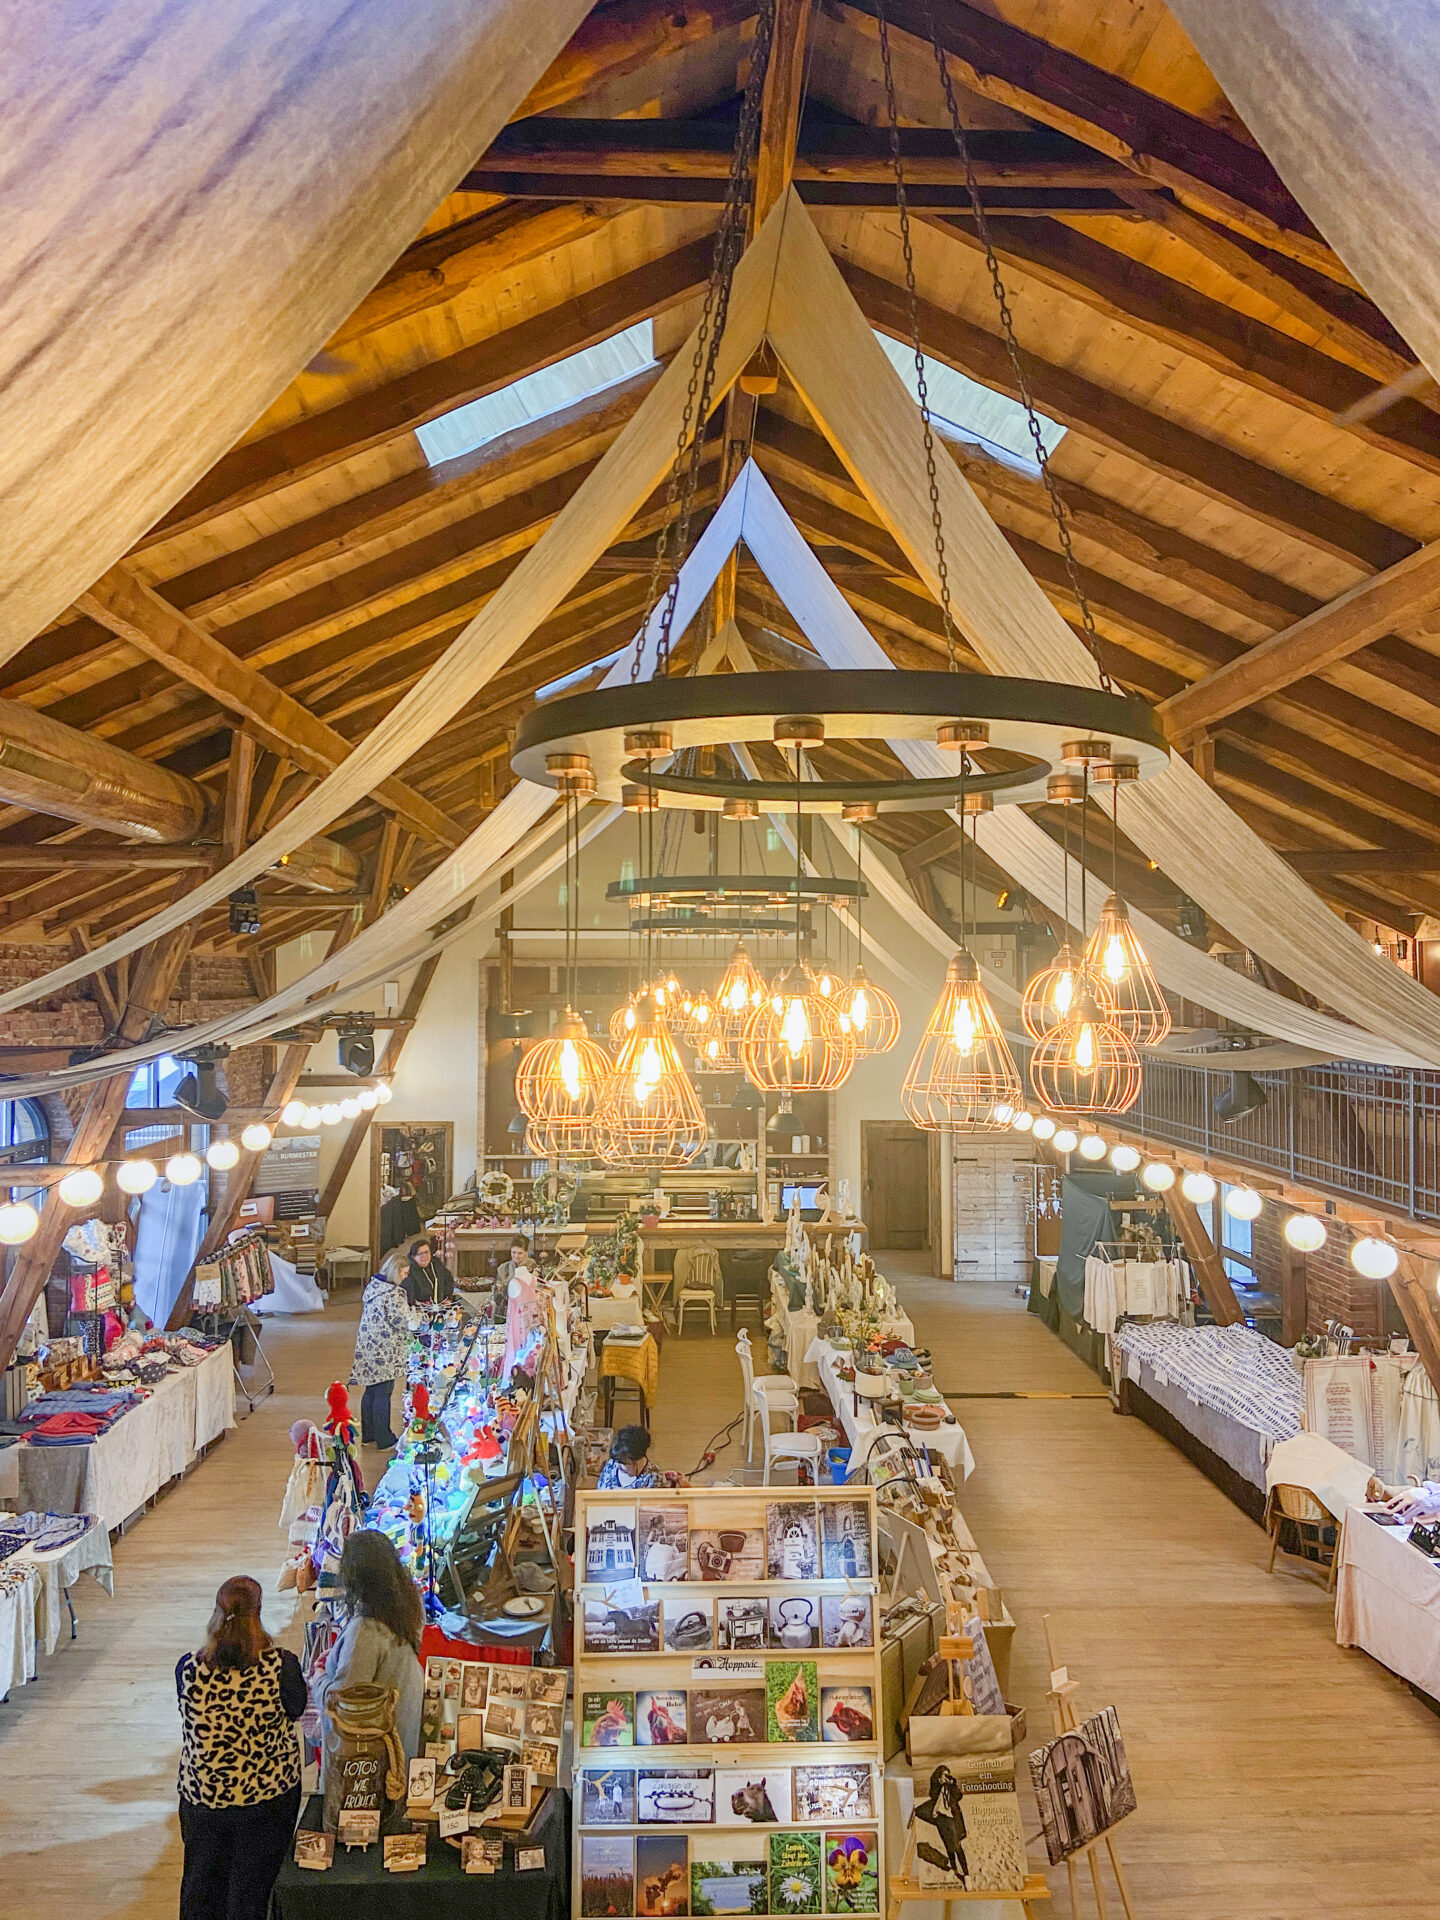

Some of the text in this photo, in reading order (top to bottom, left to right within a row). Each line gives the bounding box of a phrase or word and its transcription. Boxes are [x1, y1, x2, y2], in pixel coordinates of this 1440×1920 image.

[717, 1656, 758, 1672] Hoppovic
[343, 1760, 378, 1776] FOTOS
[979, 1771, 993, 1780] ein
[353, 1778, 369, 1792] WIE
[961, 1781, 1014, 1792] Fotoshooting
